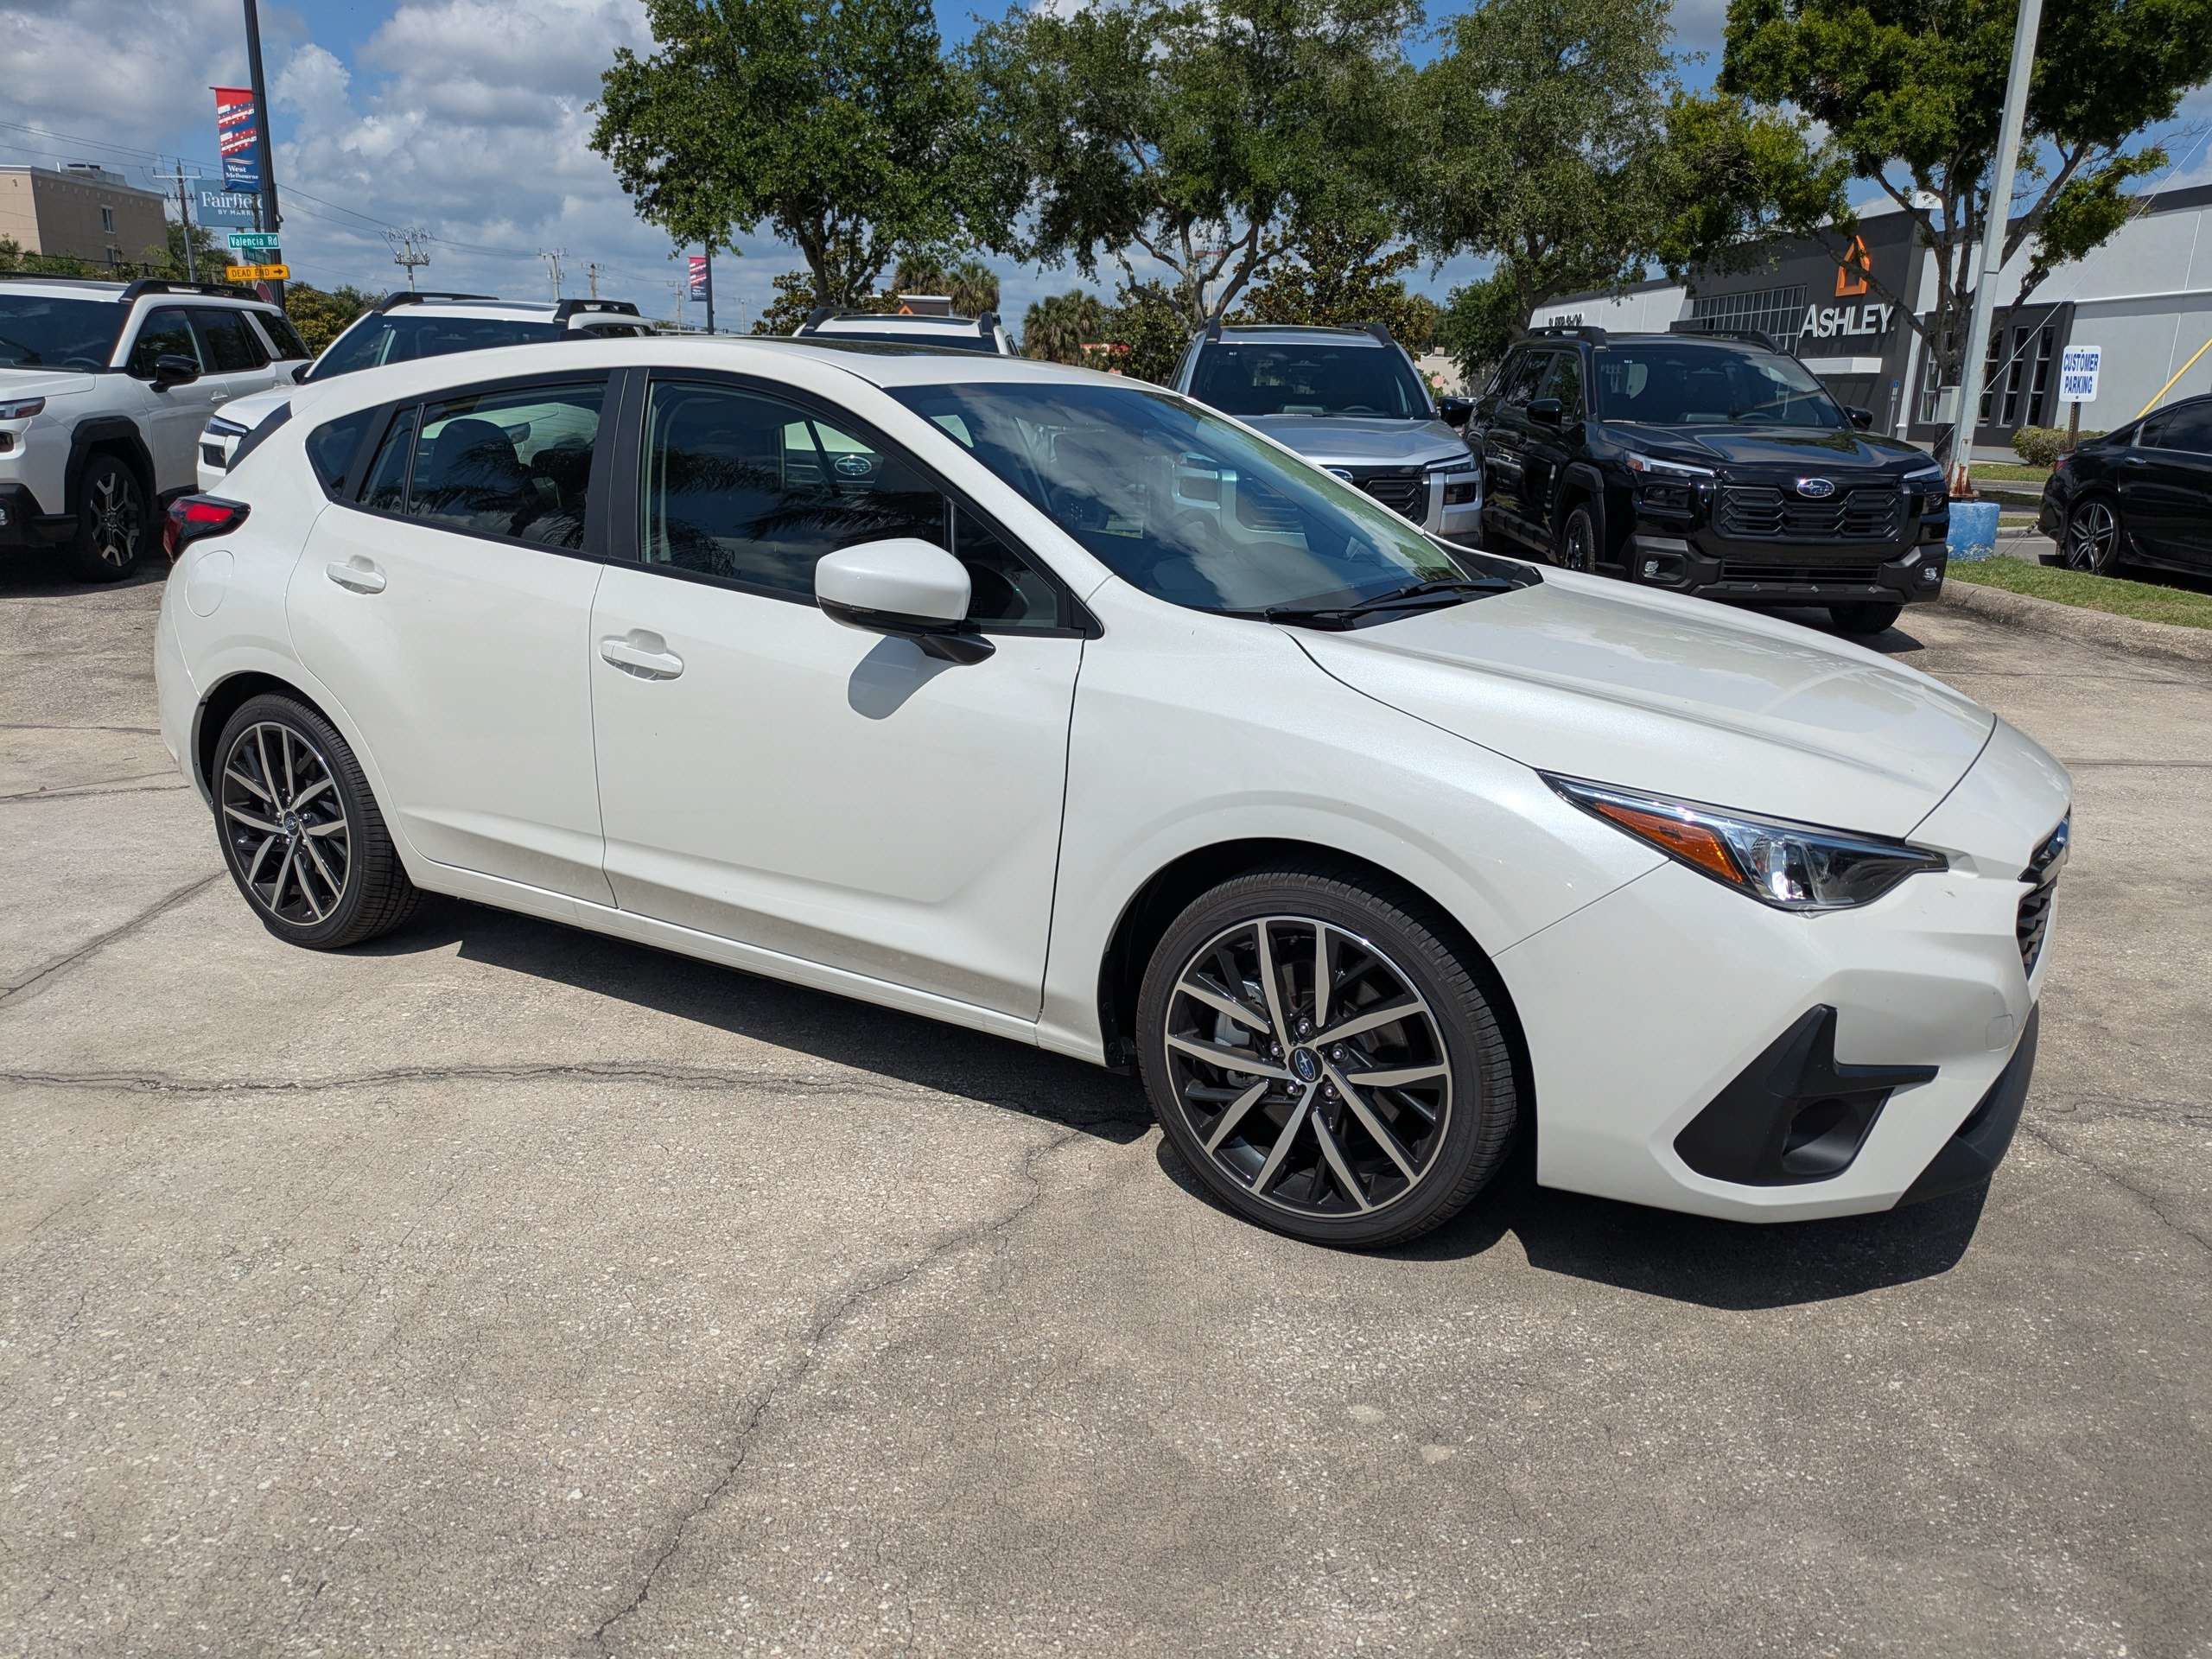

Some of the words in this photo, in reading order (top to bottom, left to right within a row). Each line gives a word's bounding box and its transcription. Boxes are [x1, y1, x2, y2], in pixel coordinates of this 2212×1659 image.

[227, 164, 247, 173] West
[200, 191, 264, 209] Fairfie
[230, 236, 264, 246] Valencia
[267, 236, 277, 245] Rd
[232, 269, 251, 277] DEAD
[255, 268, 270, 276] END
[1799, 303, 1894, 338] ASHLEY
[2063, 353, 2099, 372] CUSTOMER
[2063, 376, 2093, 394] PARKING
